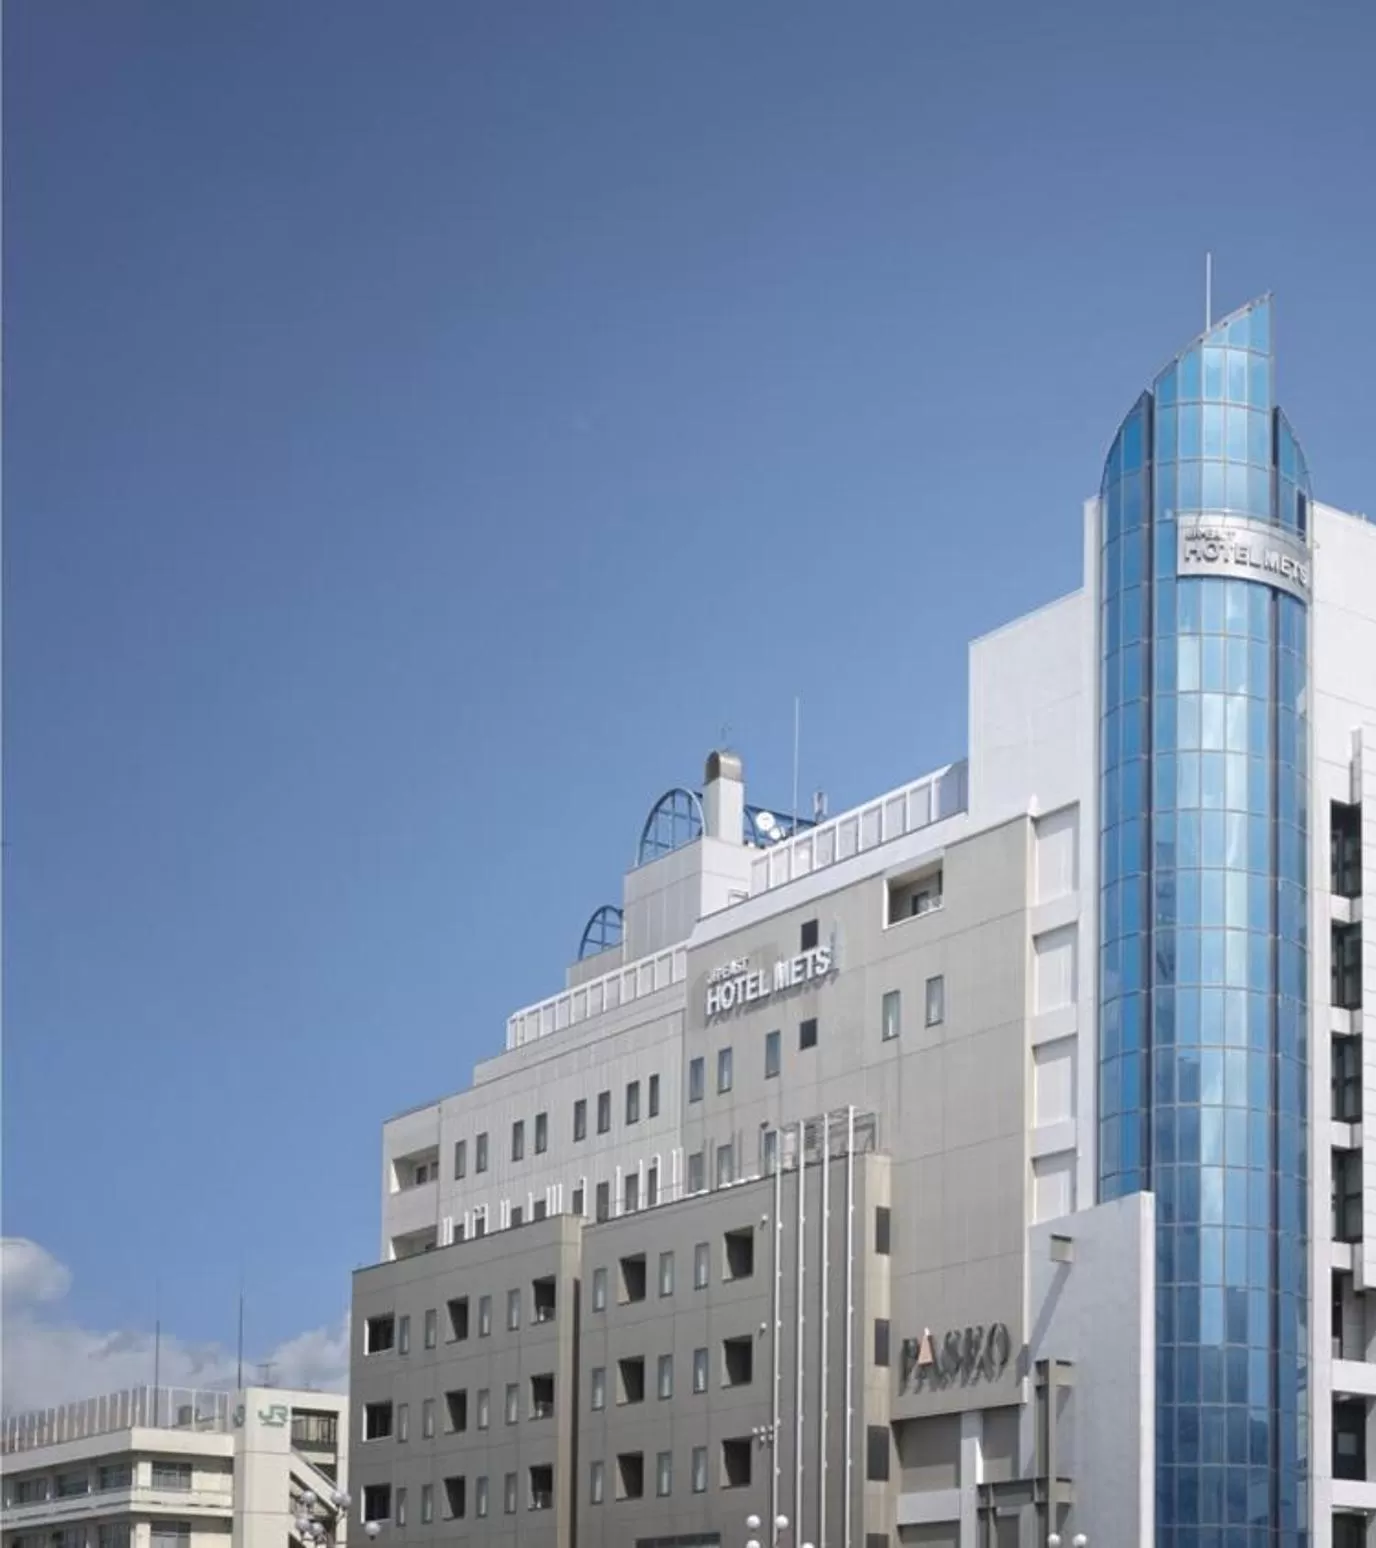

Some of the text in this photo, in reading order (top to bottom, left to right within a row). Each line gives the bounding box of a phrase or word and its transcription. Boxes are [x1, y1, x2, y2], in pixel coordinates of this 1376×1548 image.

[1184, 539, 1310, 588] HOTEL METS
[706, 944, 831, 1016] HOTEL METS
[899, 1322, 1011, 1380] PASEO
[257, 1405, 288, 1424] JR
